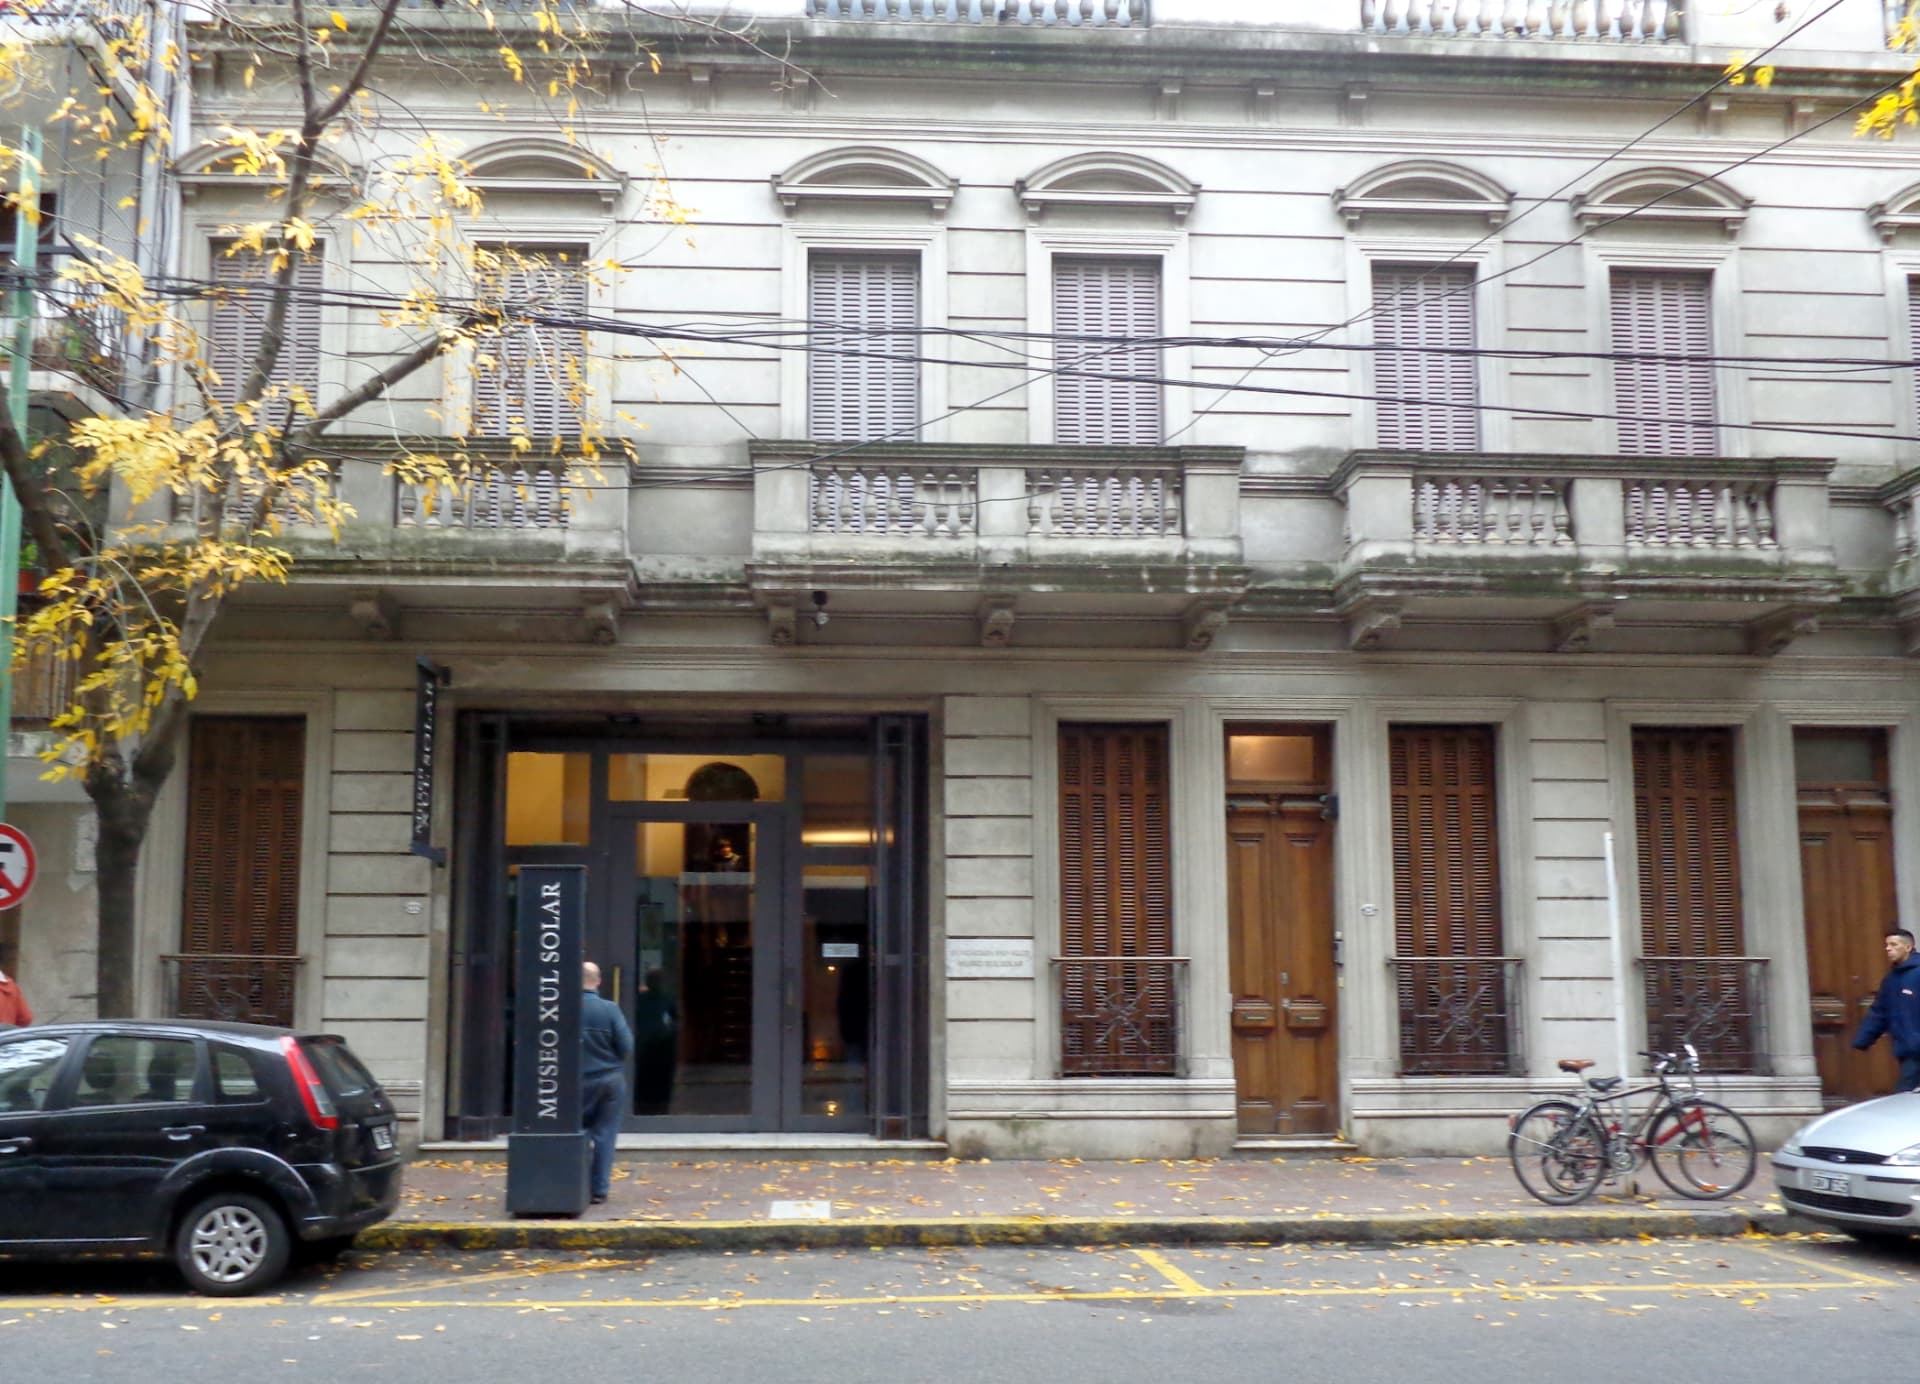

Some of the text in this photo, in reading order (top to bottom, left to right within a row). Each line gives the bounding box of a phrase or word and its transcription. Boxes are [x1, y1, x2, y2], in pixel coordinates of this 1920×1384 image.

[422, 681, 434, 767] SOLAR
[537, 881, 561, 1120] MUSEO XUL SOLAR
